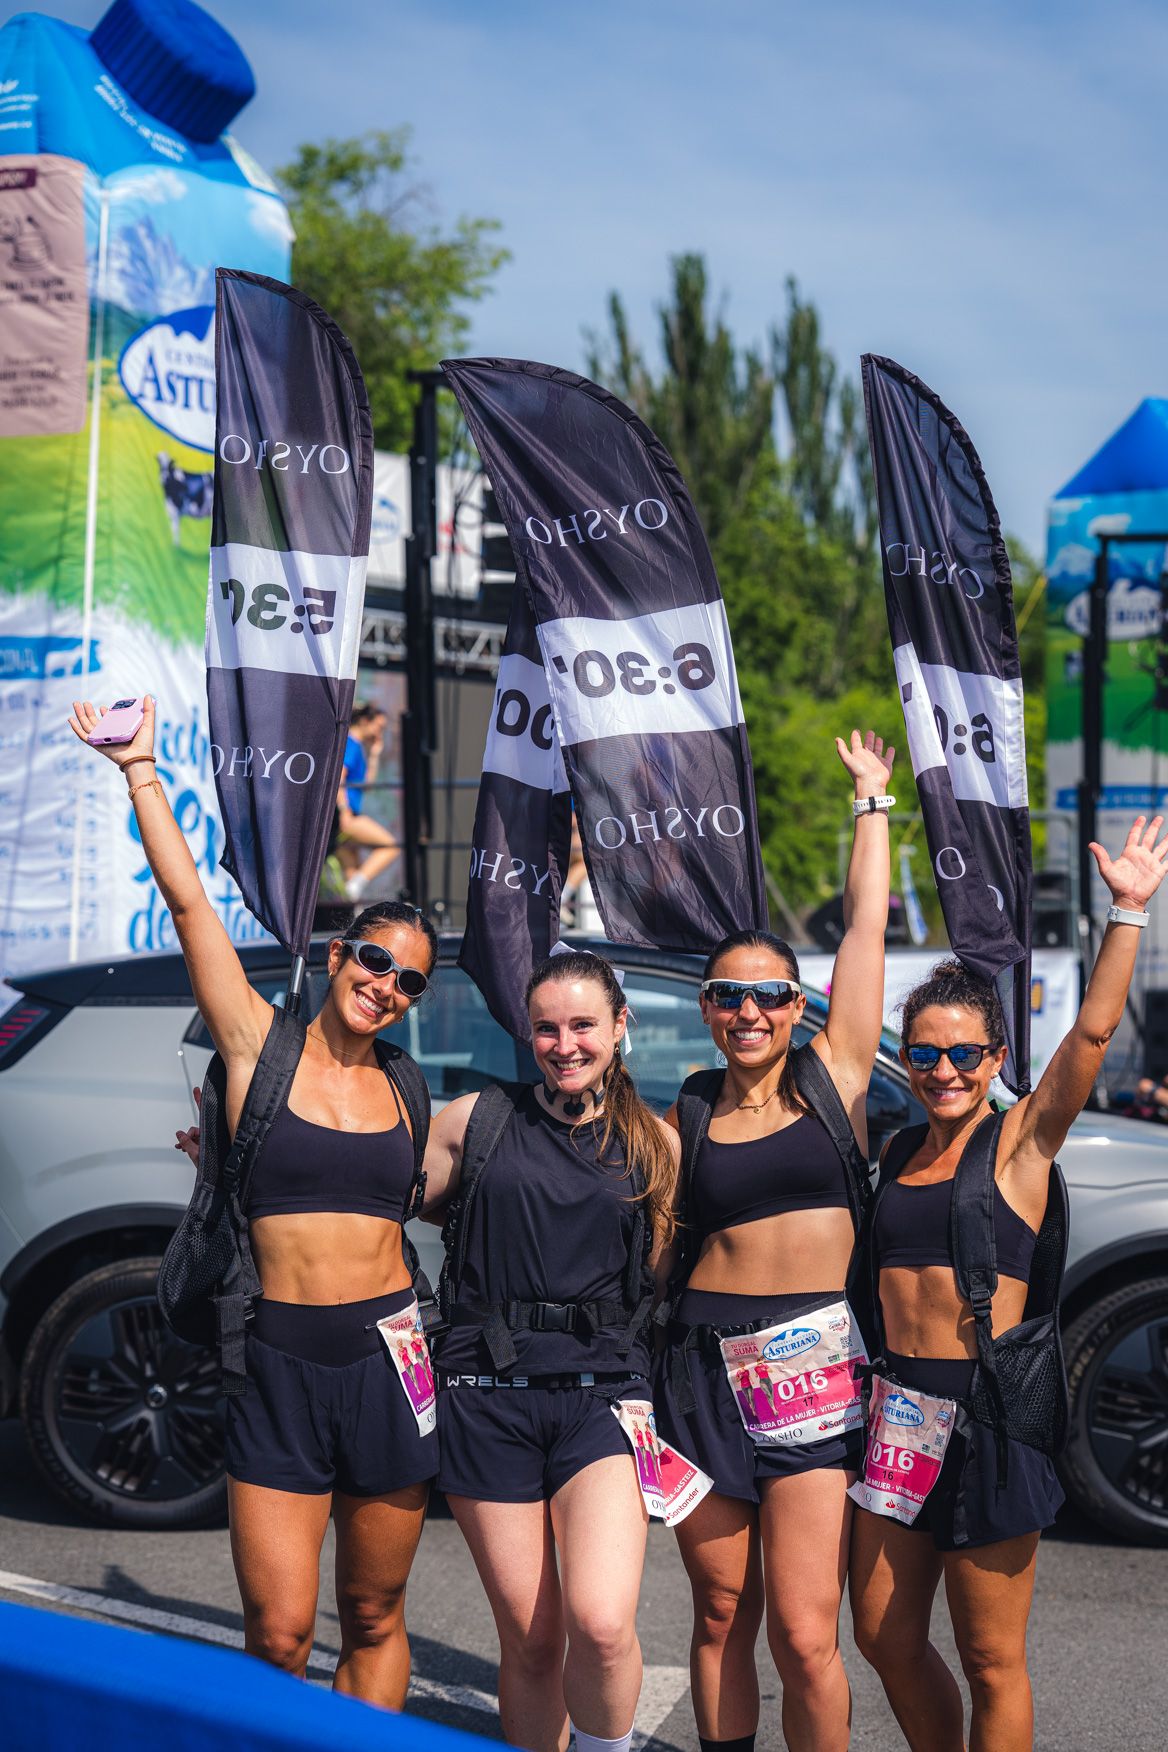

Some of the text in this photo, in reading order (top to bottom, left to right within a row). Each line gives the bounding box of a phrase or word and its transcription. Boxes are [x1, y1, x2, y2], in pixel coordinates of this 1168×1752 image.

[390, 1319, 414, 1334] SUMA
[733, 1346, 759, 1356] SUMA
[768, 1335, 818, 1358] ASTURIANA
[447, 1376, 529, 1388] WRELS
[777, 1369, 829, 1400] 016
[802, 1396, 814, 1407] 17
[627, 1408, 646, 1418] SUMA
[749, 1421, 777, 1431] CARRERA
[777, 1418, 786, 1427] DE
[785, 1415, 795, 1424] LA
[794, 1408, 817, 1421] MUJER
[762, 1427, 803, 1443] OYSHO
[872, 1441, 916, 1472] 016
[882, 1470, 894, 1481] 16
[668, 1487, 700, 1519] Santander
